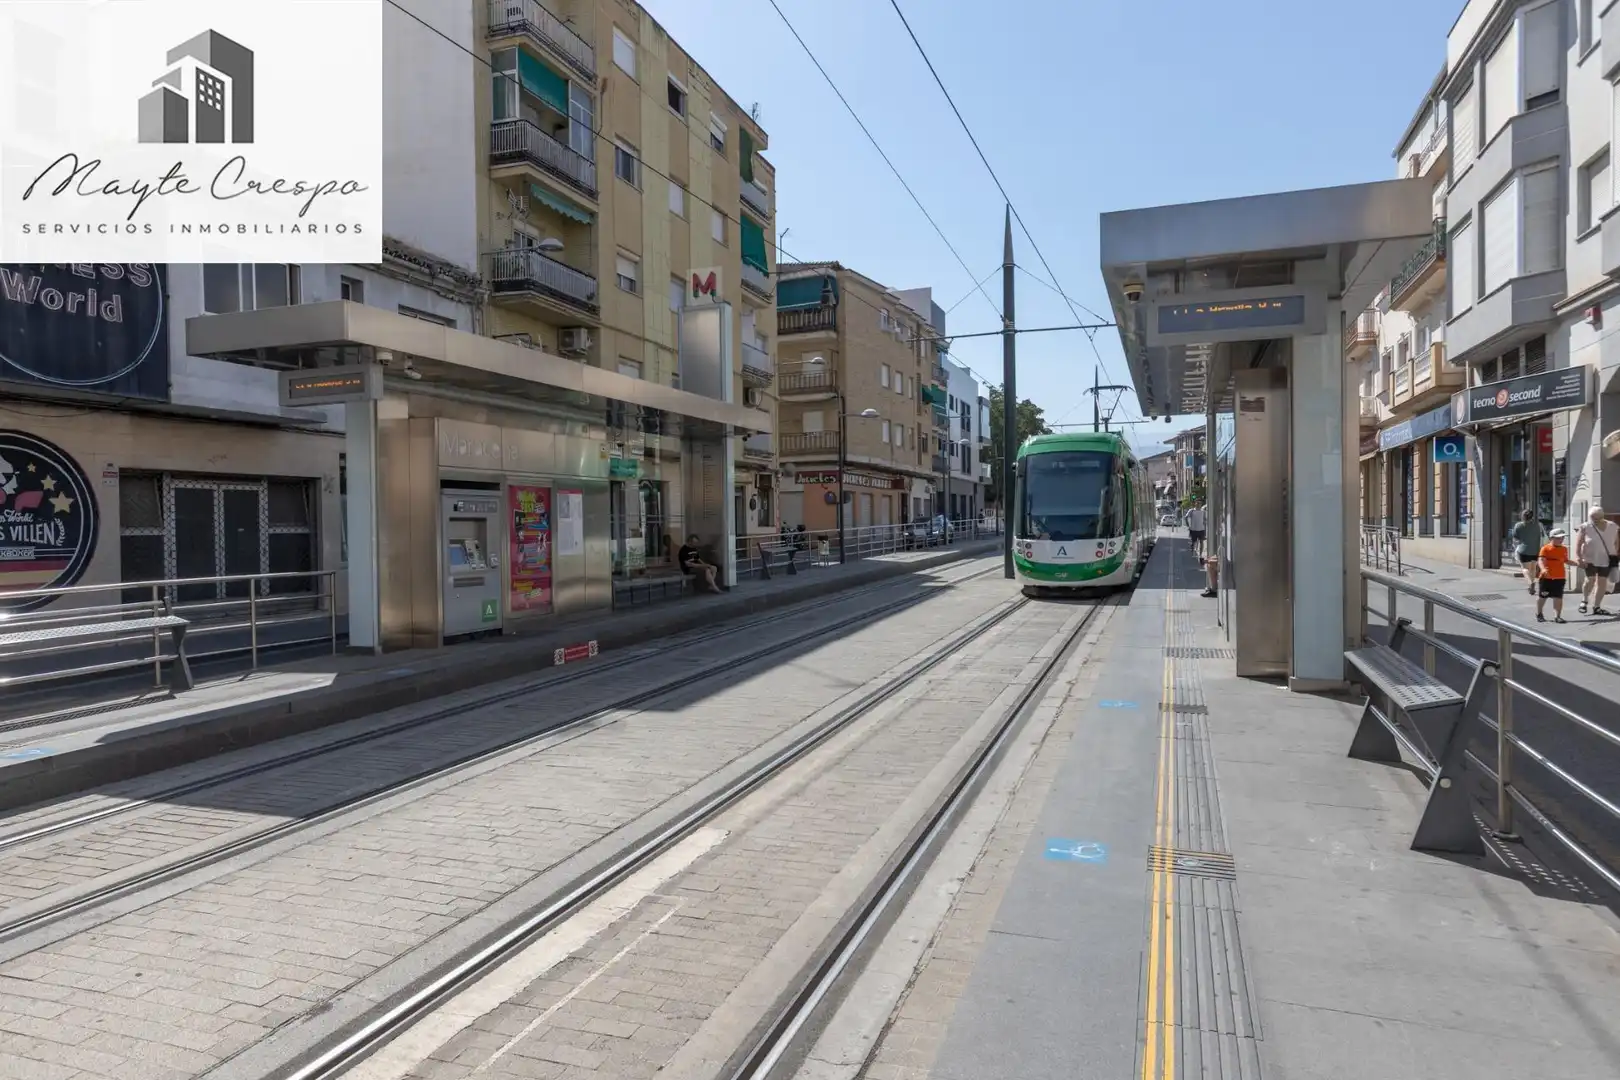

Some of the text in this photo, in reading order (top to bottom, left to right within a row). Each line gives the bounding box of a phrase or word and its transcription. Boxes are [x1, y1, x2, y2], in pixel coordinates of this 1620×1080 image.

[0, 267, 123, 323] World
[1473, 397, 1496, 409] tecno
[1508, 384, 1541, 402] second
[10, 521, 55, 546] VILLEN
